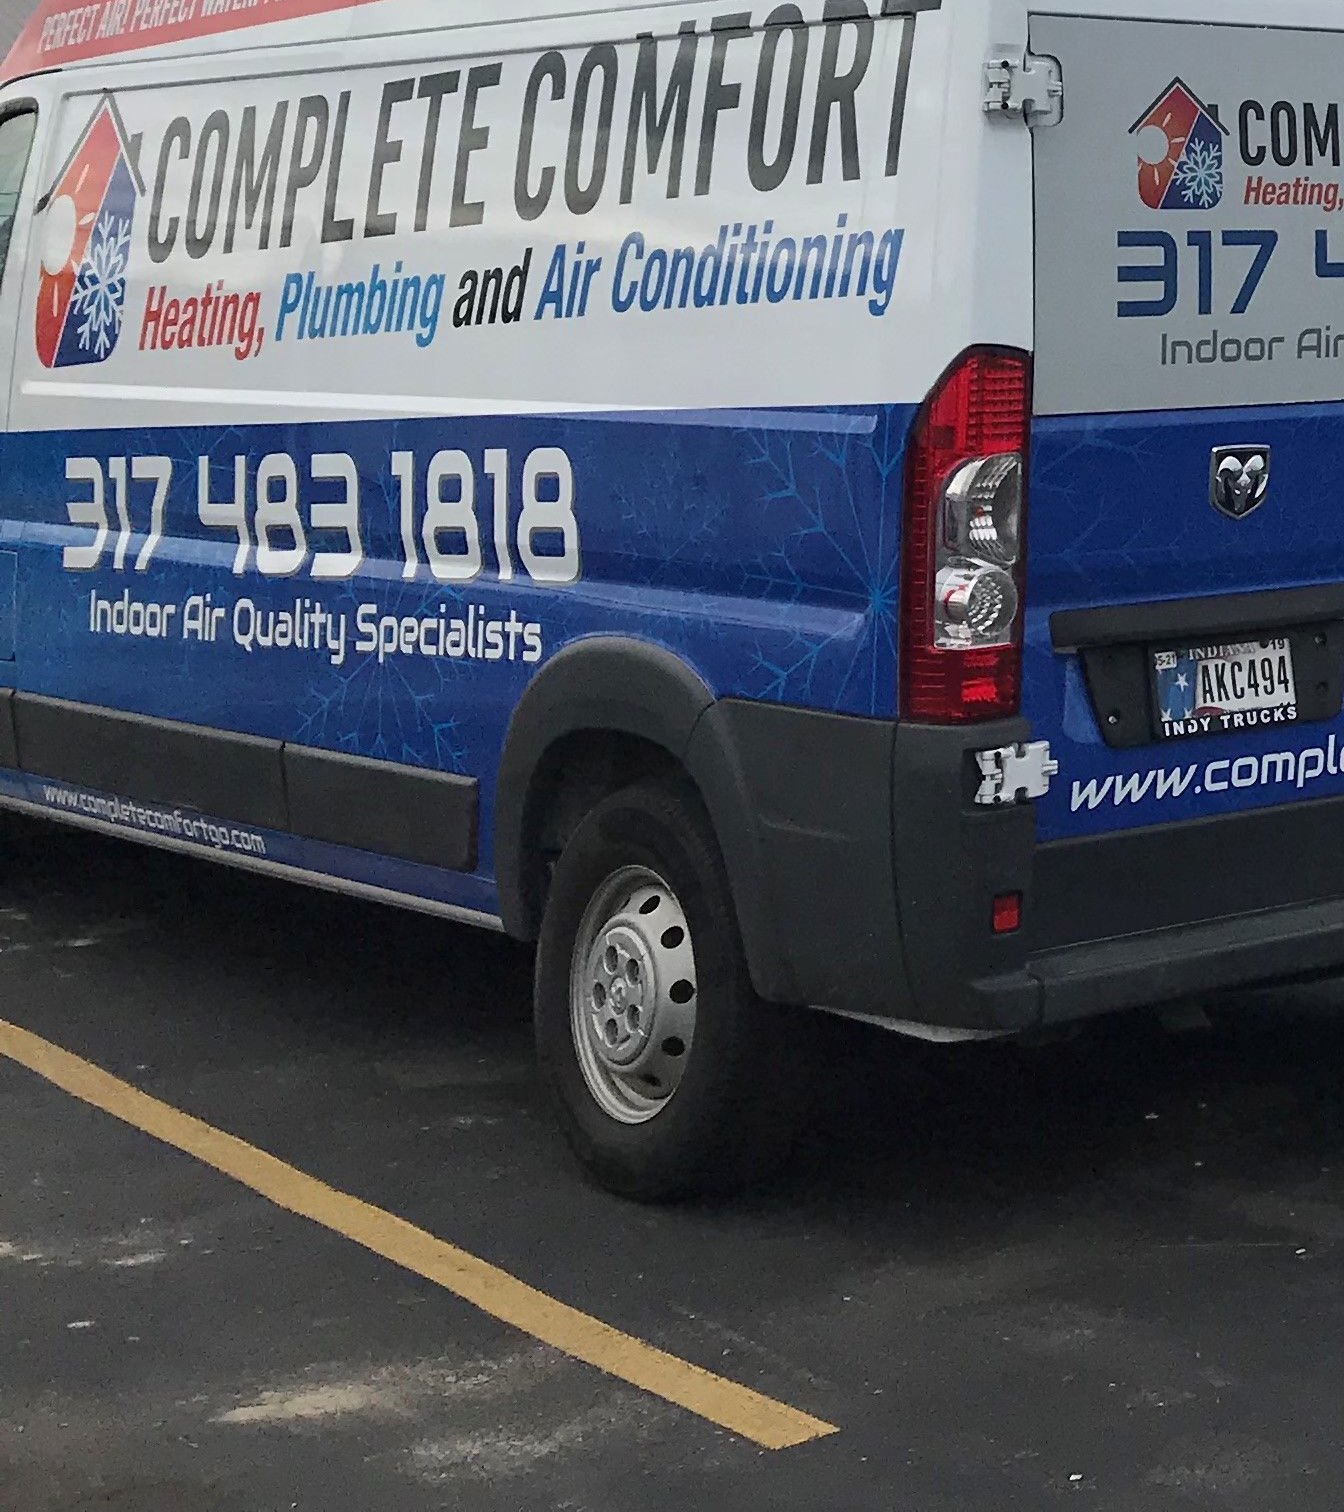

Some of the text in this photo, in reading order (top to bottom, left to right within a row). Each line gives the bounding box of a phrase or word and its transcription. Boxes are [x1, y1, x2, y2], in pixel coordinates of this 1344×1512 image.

[38, 5, 100, 53] PERFECT
[148, 63, 503, 264] COMPLETE
[1243, 176, 1344, 212] Heating,
[138, 213, 905, 360] Heating, Plumbing and Air Conditioning
[1116, 229, 1278, 318] 317
[1160, 330, 1286, 366] Indoor
[62, 447, 582, 583] 317 483 1818
[89, 589, 542, 665] Indoor Air Quality Specialists
[1201, 656, 1289, 703] AKC494
[1164, 706, 1297, 736] INDY TRUCKS
[42, 784, 266, 854] www.completecomfortgo.com
